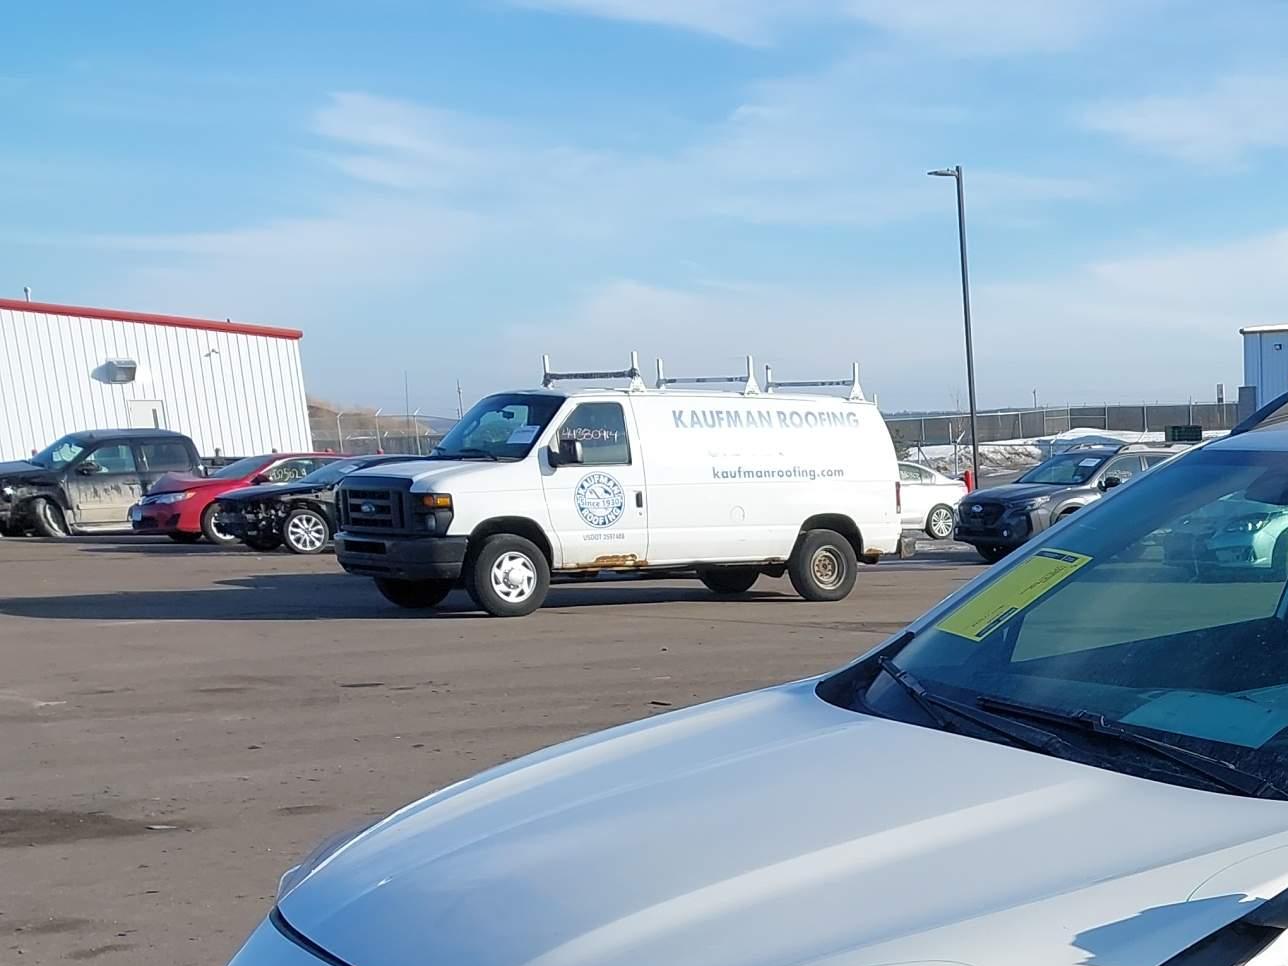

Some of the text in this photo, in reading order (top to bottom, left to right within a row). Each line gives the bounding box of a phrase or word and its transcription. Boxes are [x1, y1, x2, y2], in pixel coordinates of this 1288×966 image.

[671, 410, 860, 429] KAUFMAN ROOFING
[712, 466, 845, 480] kaufmanroofing.com
[577, 474, 622, 497] KAUFMAN
[602, 499, 621, 507] 1930
[581, 507, 621, 526] ROOFING
